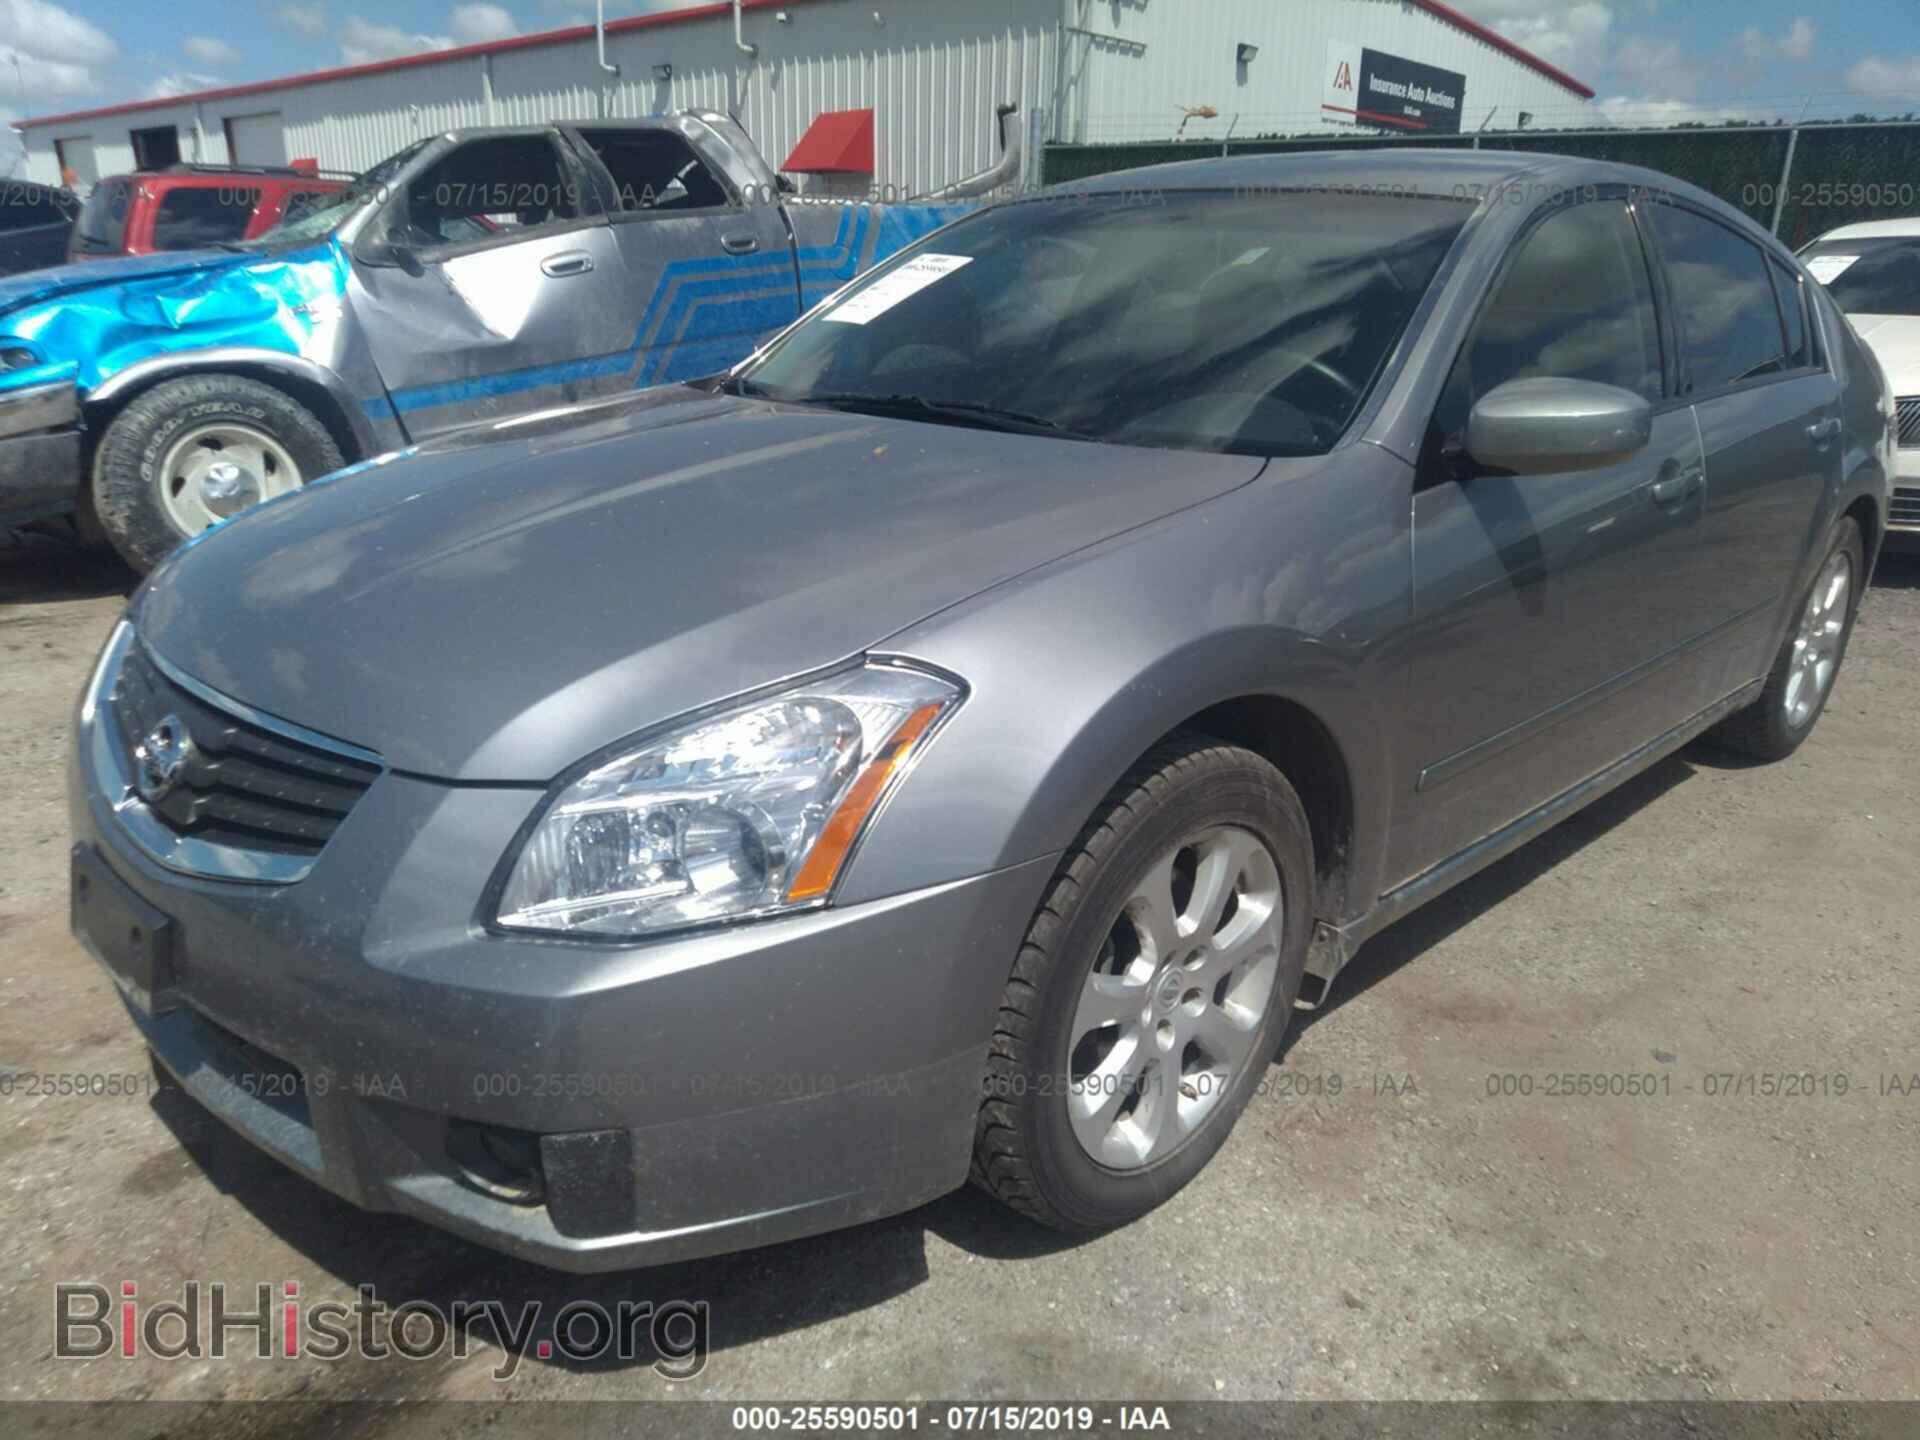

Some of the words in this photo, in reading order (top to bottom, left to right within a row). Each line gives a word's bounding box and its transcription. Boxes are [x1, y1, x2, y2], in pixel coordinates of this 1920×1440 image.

[1369, 73, 1407, 98] Insurance
[1407, 82, 1425, 101] Auto
[1424, 87, 1456, 110] Auctions
